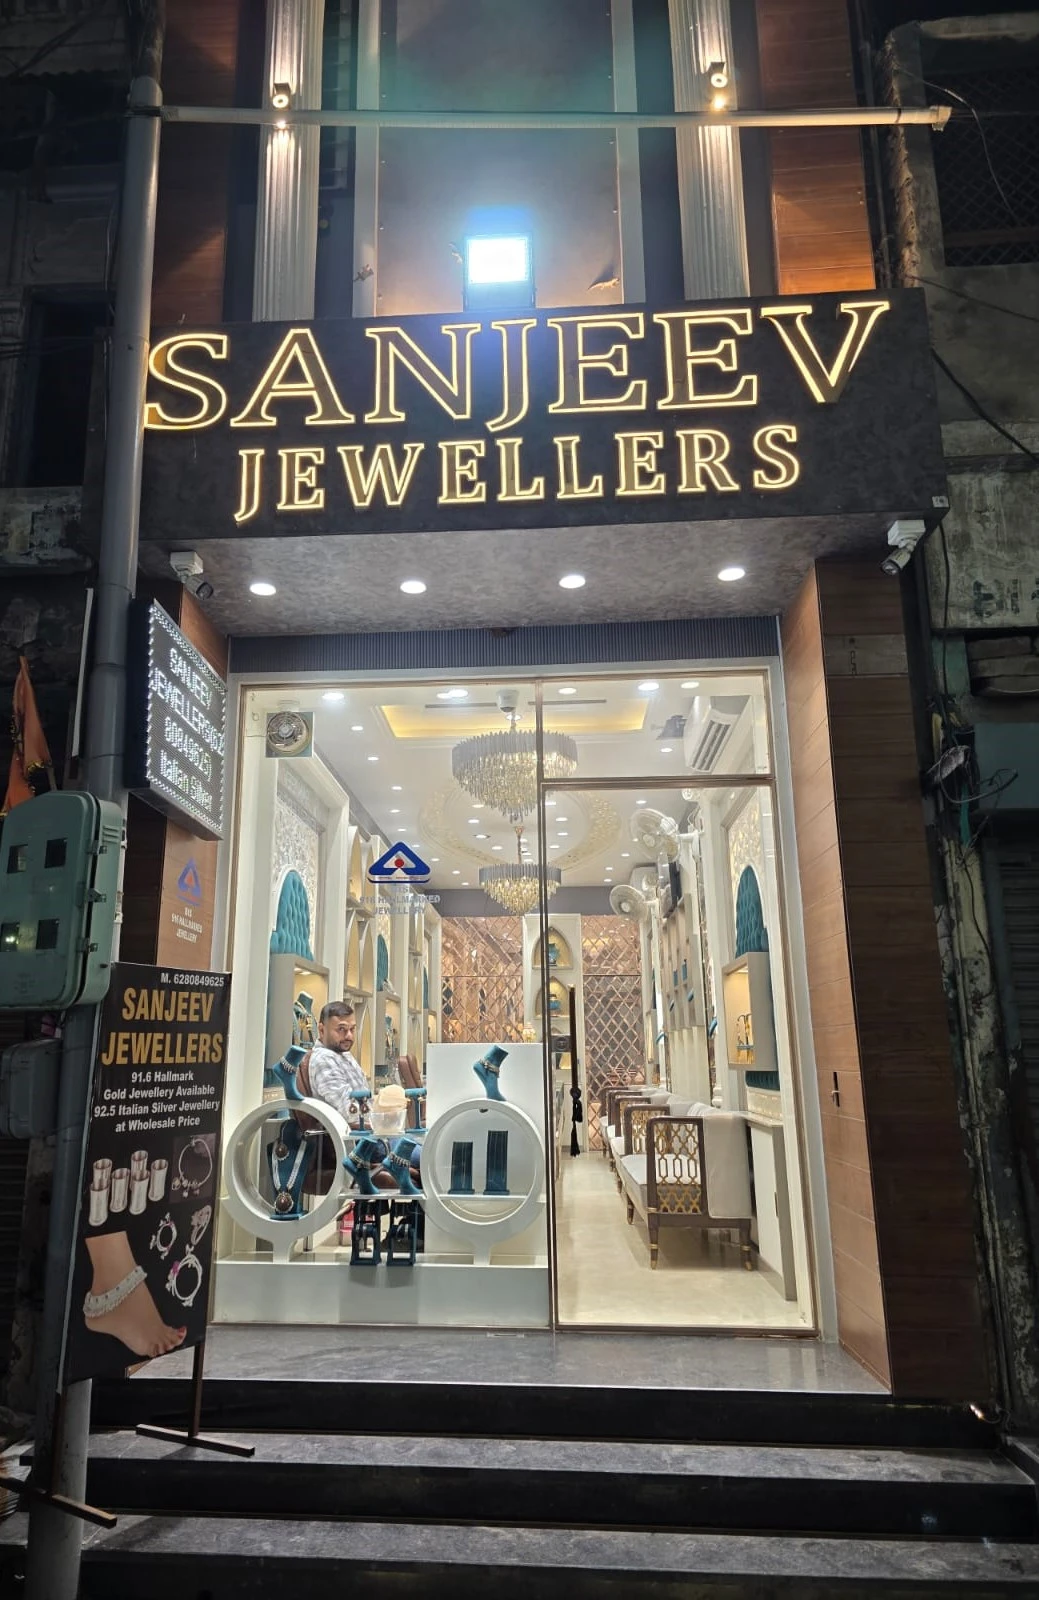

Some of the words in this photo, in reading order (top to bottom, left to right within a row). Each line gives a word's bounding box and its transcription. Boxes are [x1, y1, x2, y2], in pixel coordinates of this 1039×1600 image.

[143, 301, 890, 431] SANJEEV
[234, 425, 801, 525] JEWELLERS
[160, 973, 171, 984] M.
[173, 974, 225, 987] 6280849625
[121, 987, 215, 1022] SANJEEV
[101, 1032, 224, 1066] JEWELLERS
[131, 1071, 151, 1083] 91.6
[153, 1070, 194, 1082] Hallmark
[103, 1088, 127, 1100] Gold
[128, 1087, 174, 1100] Jewellery
[175, 1084, 215, 1097] Available
[94, 1105, 116, 1117] 92.5
[118, 1103, 149, 1116] Italian
[151, 1102, 176, 1113] Silver
[179, 1100, 220, 1113] Jewellery
[115, 1122, 126, 1133] at
[128, 1117, 175, 1131] Wholesale
[178, 1115, 201, 1127] Price
